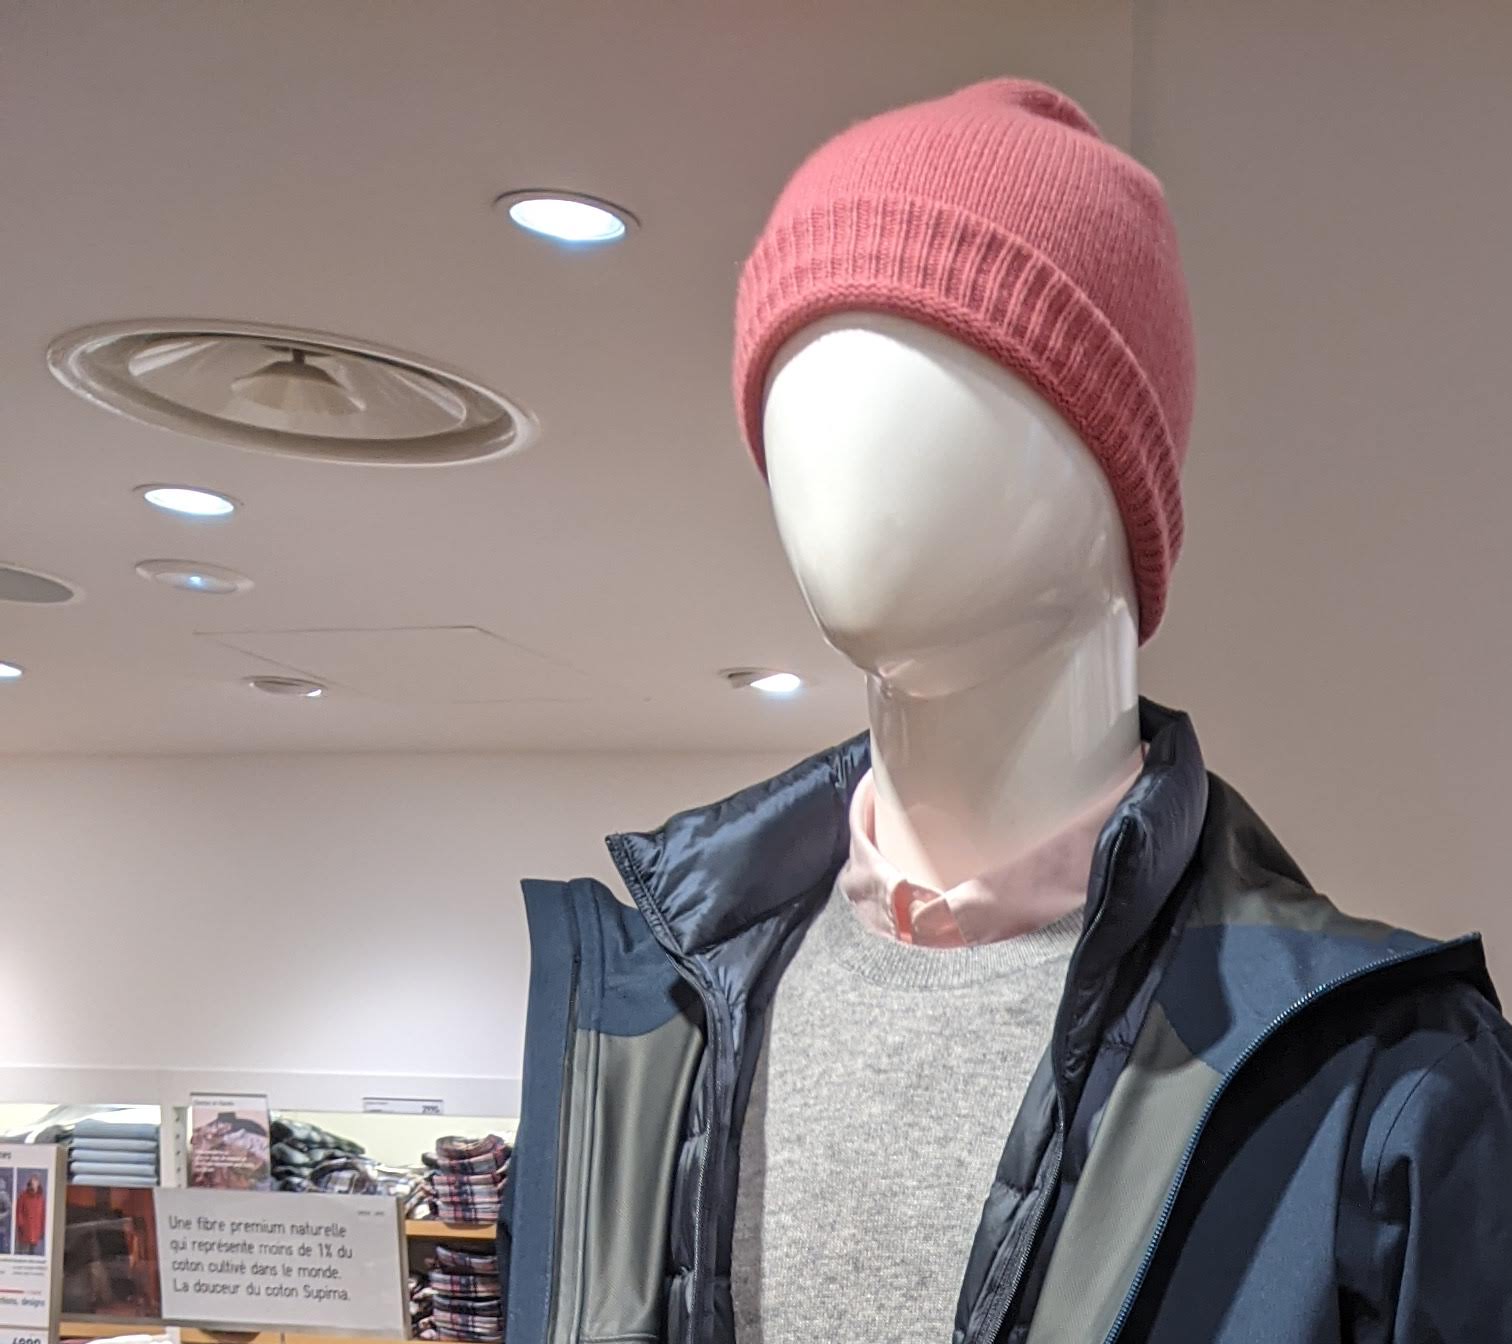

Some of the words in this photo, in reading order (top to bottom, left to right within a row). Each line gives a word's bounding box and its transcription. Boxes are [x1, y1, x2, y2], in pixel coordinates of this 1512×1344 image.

[169, 1215, 192, 1231] Une
[197, 1216, 226, 1232] fibre
[230, 1219, 285, 1237] premium
[290, 1223, 347, 1238] naturelle
[170, 1239, 188, 1255] qui
[191, 1240, 255, 1256] représente
[259, 1243, 294, 1256] moins
[297, 1243, 313, 1258] de
[318, 1243, 333, 1258] 1%
[337, 1245, 353, 1259] du
[171, 1259, 204, 1273] coton
[208, 1260, 247, 1274] cultivé
[251, 1262, 278, 1277] dans
[282, 1264, 293, 1277] le
[298, 1264, 342, 1279] monde.
[172, 1278, 190, 1293] La
[193, 1279, 241, 1295] douceur
[246, 1281, 261, 1296] du
[266, 1283, 299, 1298] coton
